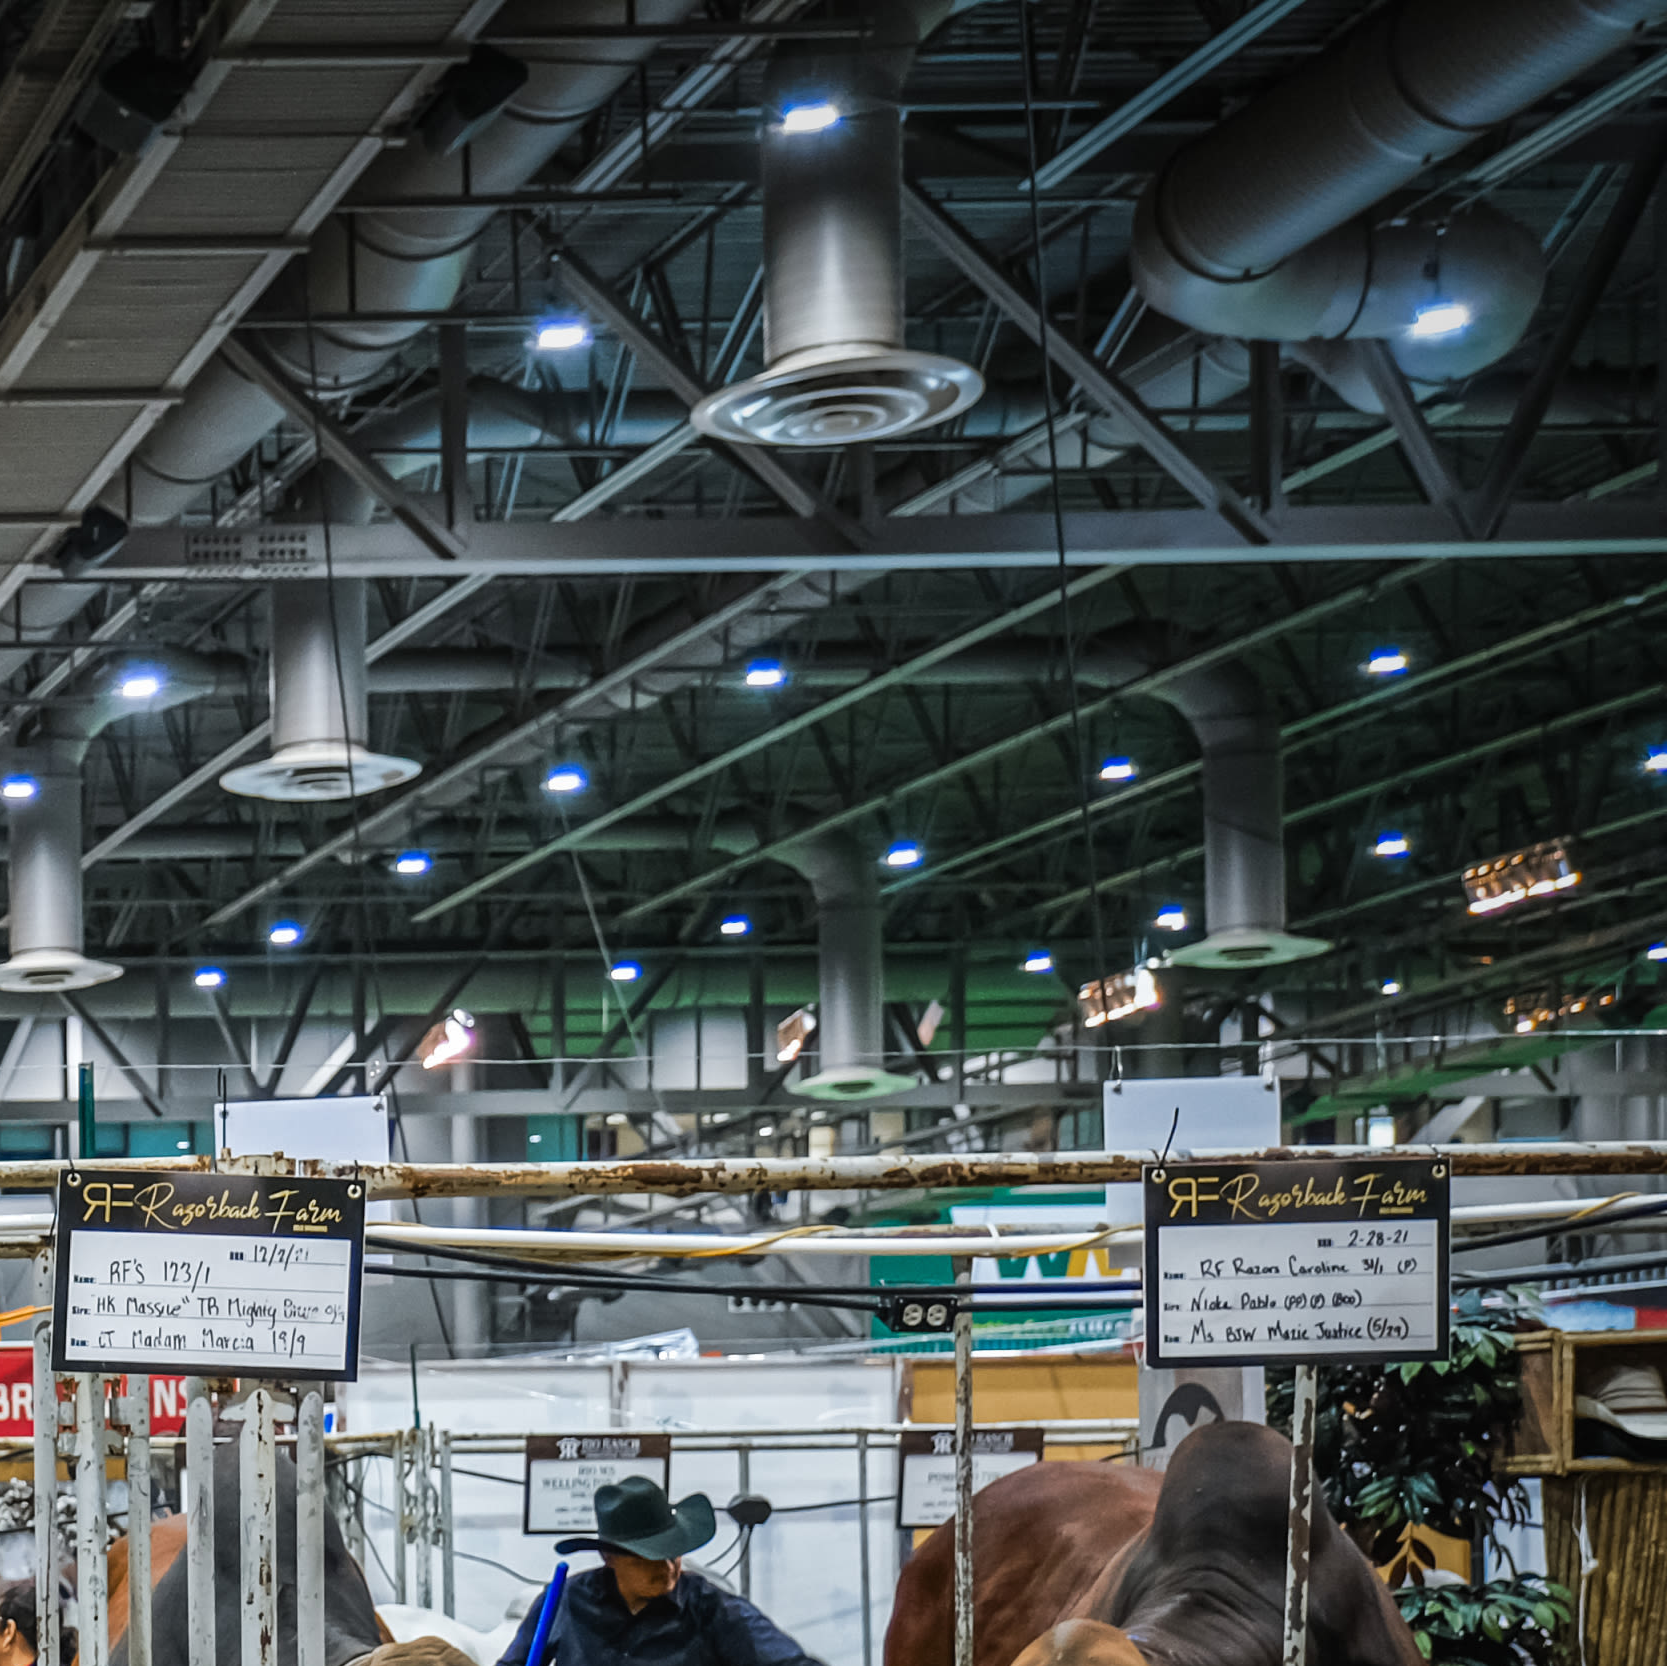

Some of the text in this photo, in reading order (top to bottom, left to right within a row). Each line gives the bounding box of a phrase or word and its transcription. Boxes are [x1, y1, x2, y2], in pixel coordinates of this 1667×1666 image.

[134, 1181, 261, 1230] Razorback
[263, 1189, 343, 1234] Farm
[1220, 1173, 1347, 1221] Razorback
[1350, 1173, 1428, 1218] Farm
[1347, 1229, 1408, 1248] 2-28-21
[164, 1260, 210, 1293] 123/1
[1200, 1259, 1225, 1278] RF
[1289, 1254, 1349, 1277] Caroline
[1397, 1257, 1417, 1274] (P)
[197, 1296, 220, 1317] TR
[227, 1297, 277, 1330] Mighty
[1240, 1292, 1276, 1310] Pablo
[132, 1326, 186, 1350] Madam
[202, 1328, 254, 1351] Marcia
[1190, 1317, 1214, 1344] Ms
[1315, 1321, 1363, 1339] Justice
